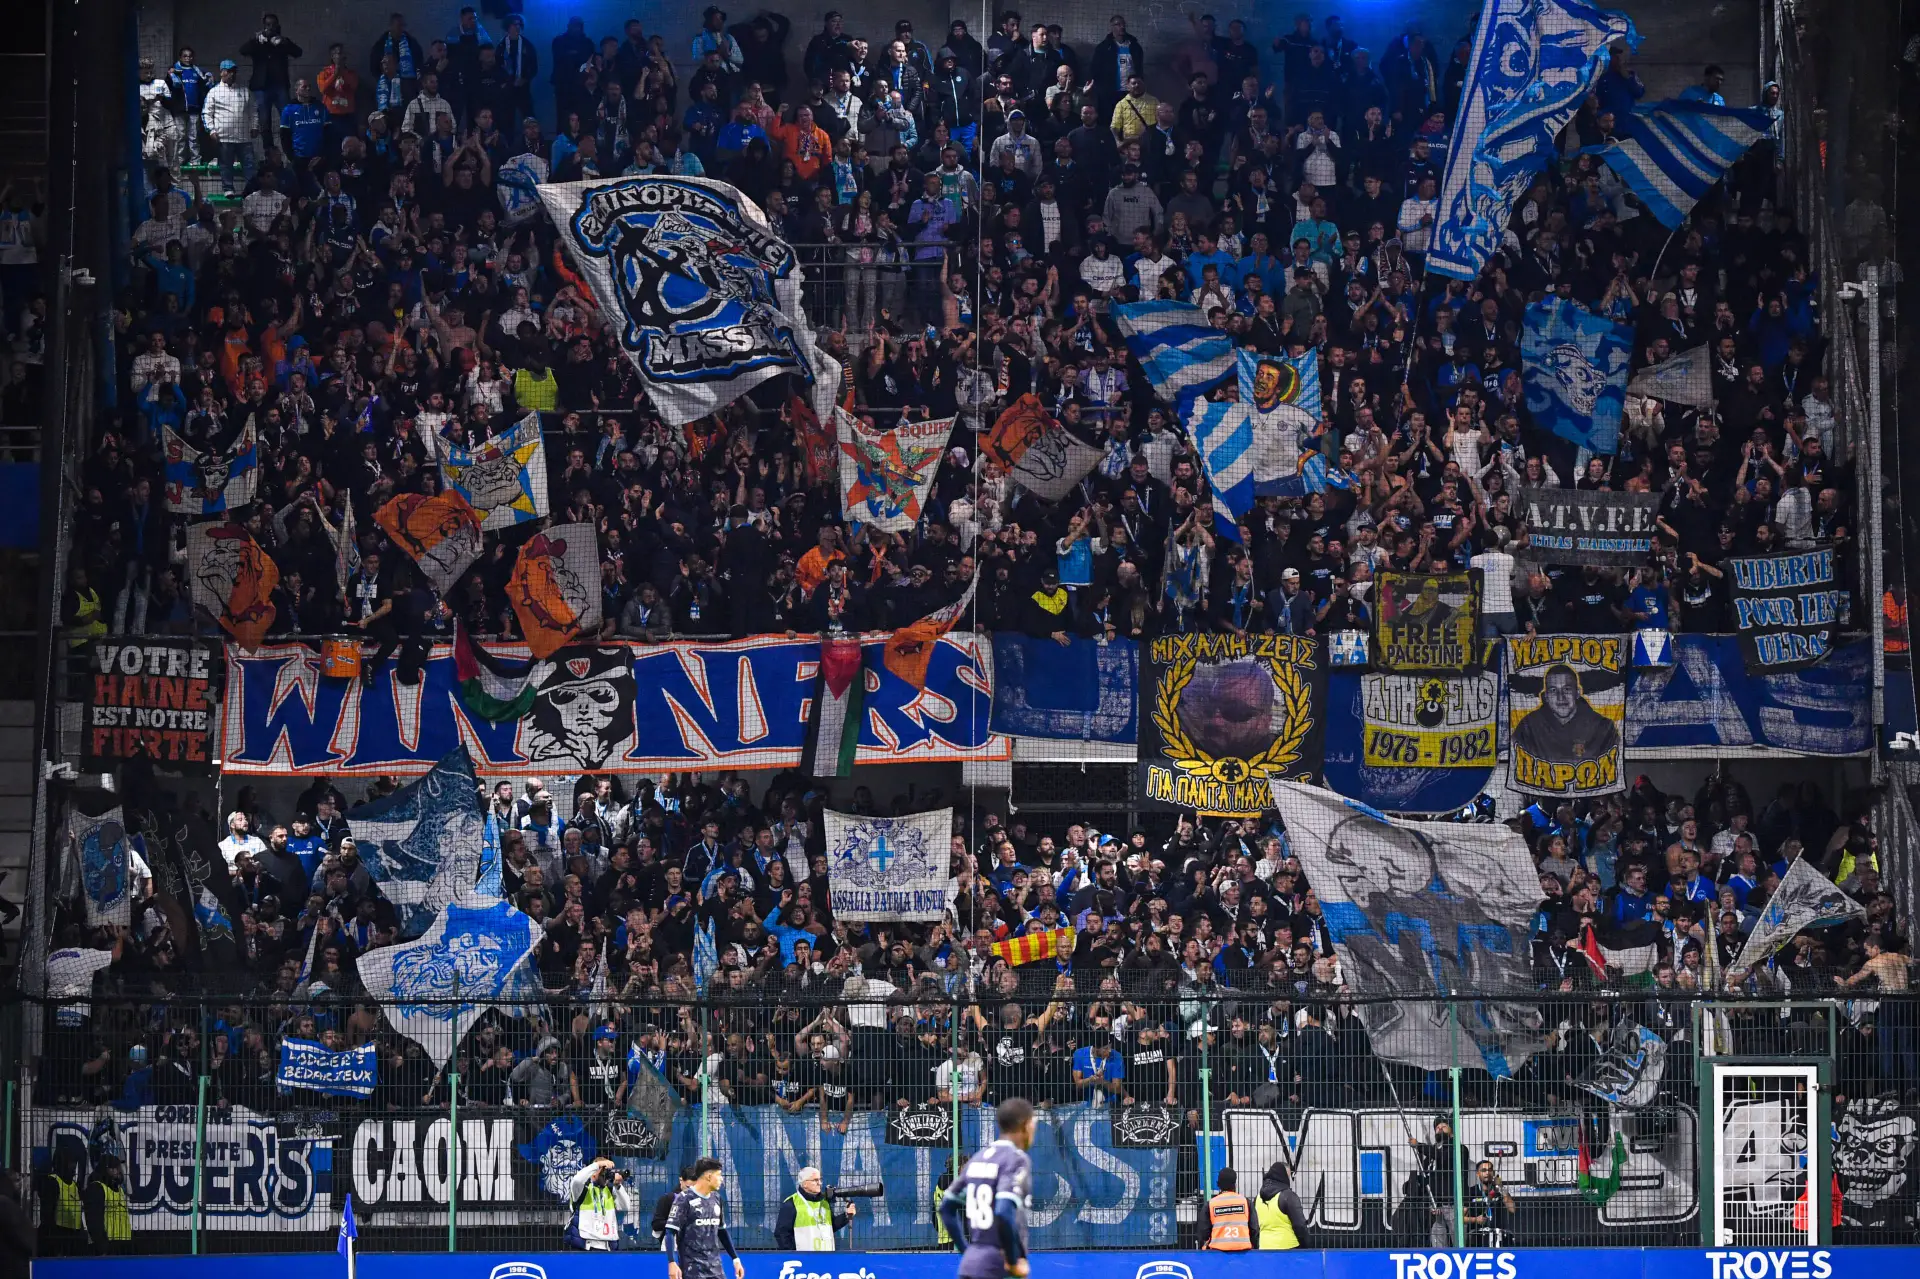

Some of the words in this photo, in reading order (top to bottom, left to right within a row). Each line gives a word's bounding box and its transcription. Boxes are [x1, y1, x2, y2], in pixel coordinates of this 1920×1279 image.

[1730, 548, 1834, 590] LIBERTE
[1734, 595, 1799, 630] POUR
[1390, 621, 1459, 646] FREE
[96, 644, 211, 679] VOTRE
[1386, 643, 1464, 666] PALESTINE
[94, 674, 209, 710] HAINE
[92, 705, 131, 727] EST
[135, 707, 208, 731] NOTRE
[91, 726, 207, 762] FIERTE
[1368, 727, 1420, 764] 1975
[1438, 727, 1492, 765] 1982
[155, 1105, 234, 1125] CORINE
[617, 1121, 646, 1135] NICO
[49, 1121, 317, 1219] DDGER'S
[352, 1117, 516, 1204] CAOM
[1223, 1225, 1240, 1239] 23
[509, 1266, 528, 1274] 1986
[1155, 1265, 1174, 1273] 1986
[1389, 1252, 1517, 1279] TROYES
[1705, 1251, 1833, 1279] TROYES
